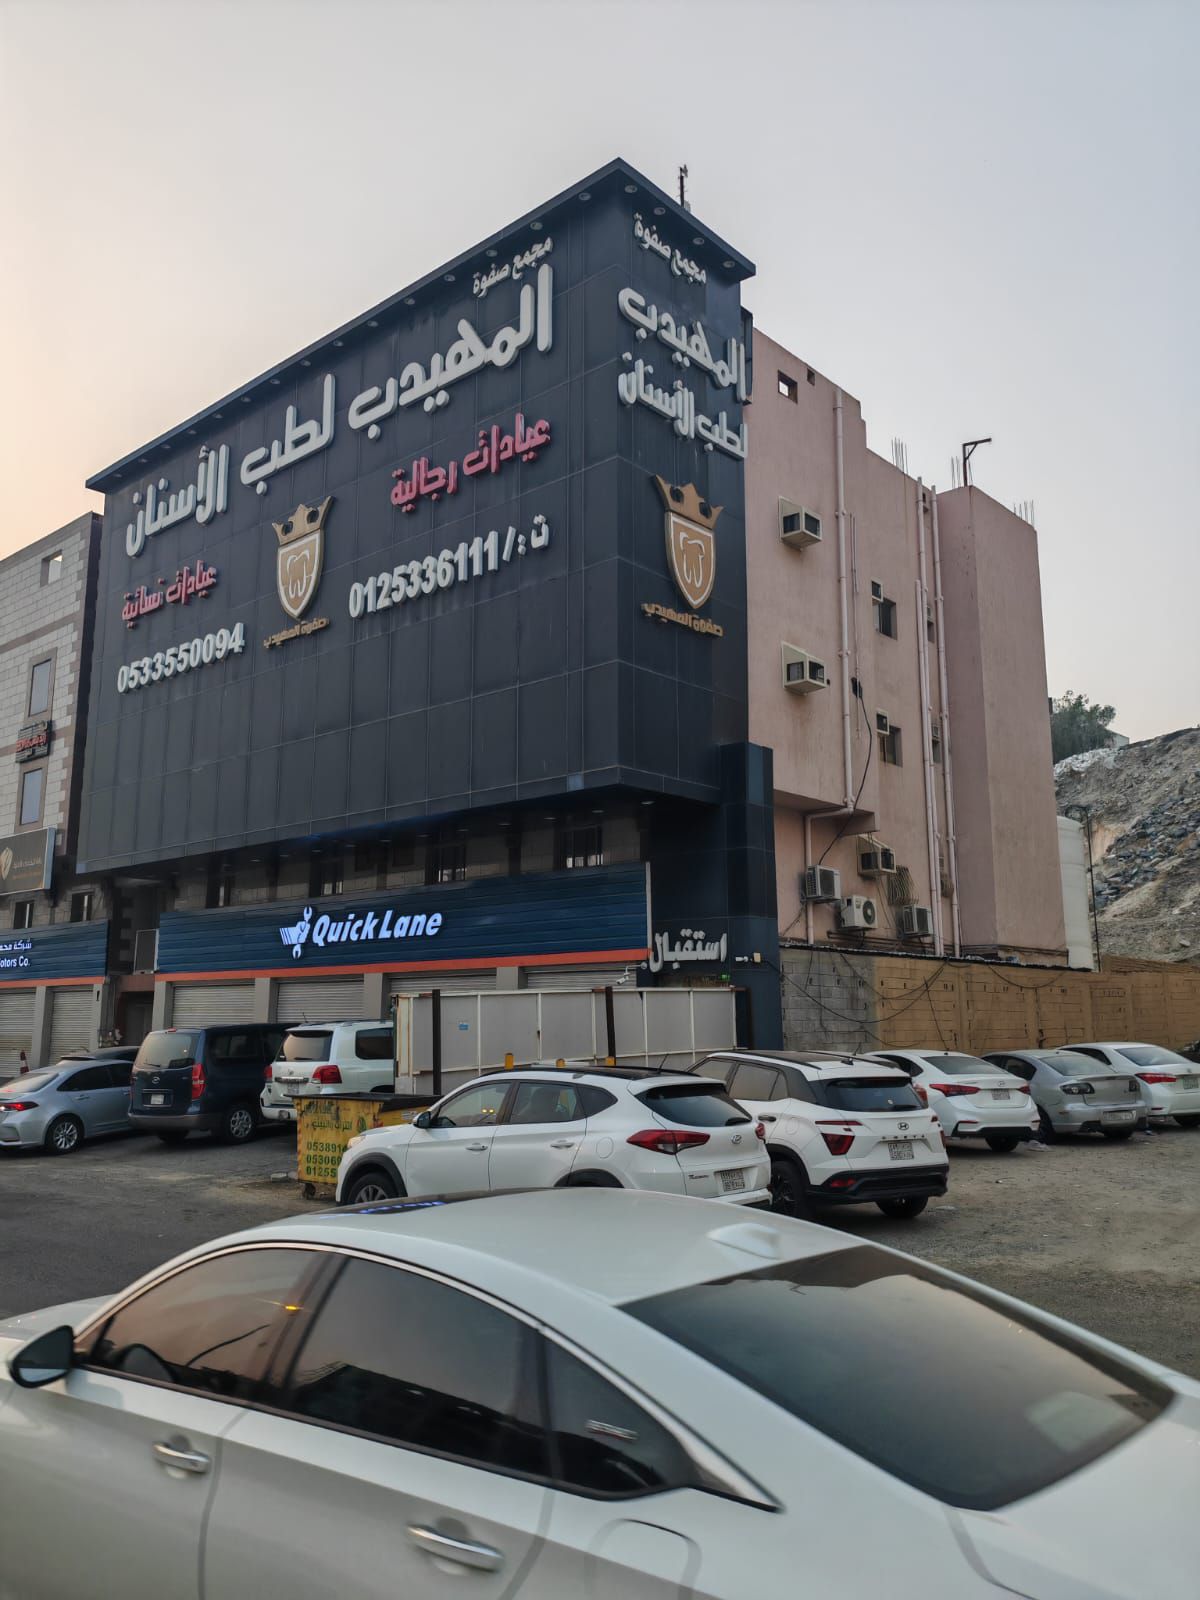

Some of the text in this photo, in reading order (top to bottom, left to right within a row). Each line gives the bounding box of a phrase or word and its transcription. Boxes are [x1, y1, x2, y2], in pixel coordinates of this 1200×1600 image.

[472, 236, 553, 298] مجمع صفوة
[633, 211, 707, 285] مجمع صفوة
[617, 286, 748, 402] المهيدب
[125, 263, 553, 557] المهيدب لطب الأسنان
[617, 351, 749, 462] لطب الأسنان
[389, 412, 552, 514] عيادات رجالية
[121, 558, 218, 630] عيادات نسائية
[348, 529, 500, 619] 0125336111
[116, 621, 246, 694] 0533550094
[0, 957, 18, 968] otors
[648, 928, 728, 973] استقبال
